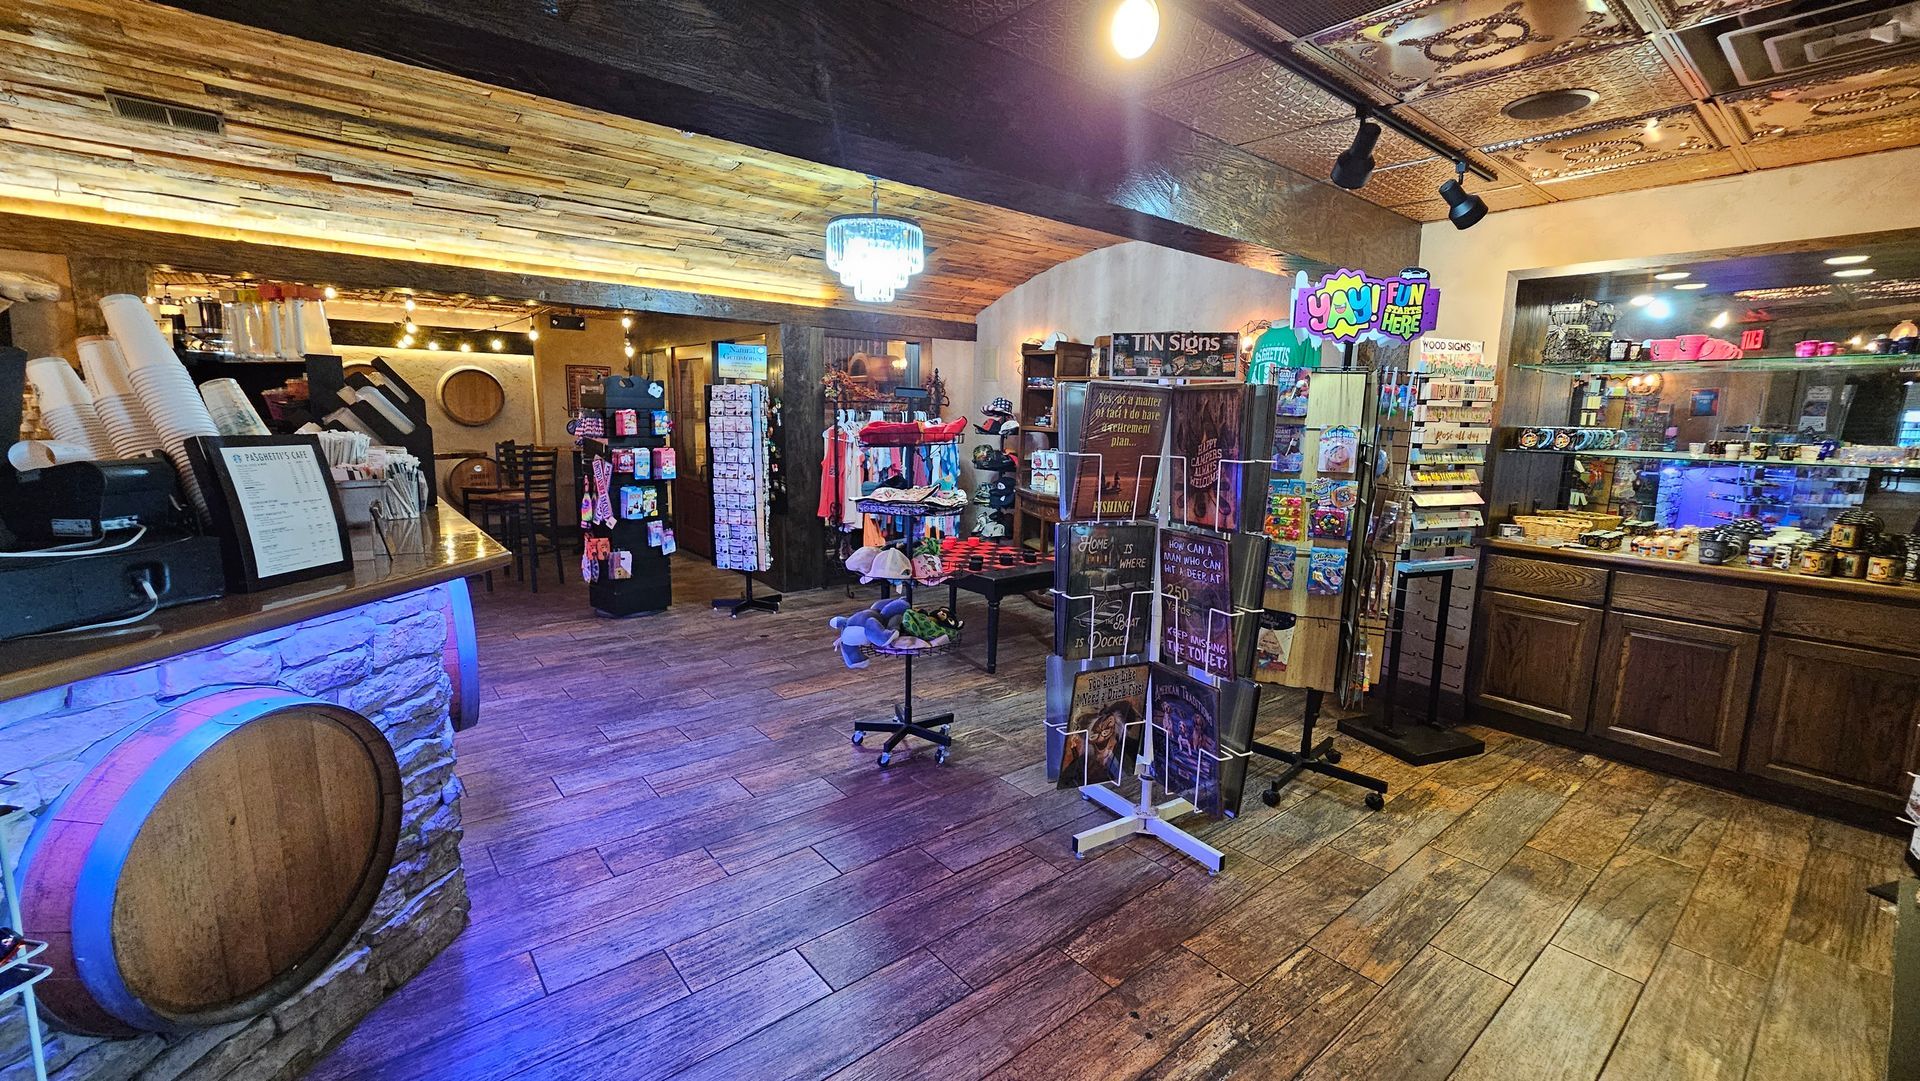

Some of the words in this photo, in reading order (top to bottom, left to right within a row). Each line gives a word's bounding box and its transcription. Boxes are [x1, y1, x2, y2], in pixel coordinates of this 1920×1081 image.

[1386, 281, 1426, 307] FUN
[1307, 283, 1381, 332] YAY!
[1384, 304, 1423, 315] STARTS
[1380, 313, 1422, 337] HERE
[729, 345, 756, 354] Natural
[1131, 334, 1164, 351] TIN
[1168, 334, 1221, 356] Signs
[1423, 340, 1446, 351] WOOD
[1447, 341, 1472, 352] SIGNS
[722, 352, 762, 361] Gemstones
[1116, 395, 1126, 405] as
[1128, 396, 1134, 405] a
[1136, 396, 1162, 407] matter
[1095, 407, 1105, 417] of
[1106, 408, 1121, 418] fact
[1123, 408, 1128, 419] I
[1129, 408, 1140, 419] do
[1141, 409, 1161, 420] have
[1110, 422, 1151, 434] retirement
[1326, 430, 1354, 438] Unicorn
[1110, 436, 1137, 448] plan...
[1455, 430, 1466, 441] all
[1467, 431, 1480, 443] day
[291, 450, 308, 460] CAFE
[1197, 438, 1217, 456] HAPPY
[1190, 448, 1222, 467] CAMPERS
[1193, 460, 1217, 477] ALWAYS
[1091, 500, 1134, 513] FISHING!
[1078, 535, 1109, 554] HOME
[1123, 543, 1134, 554] IS
[1168, 539, 1184, 552] HOW
[1186, 542, 1205, 555] CAN
[1207, 545, 1214, 557] A
[1119, 557, 1147, 569] WHERE
[1163, 551, 1181, 563] MAN
[1183, 555, 1201, 566] WHO
[1202, 558, 1221, 571] CAN
[1164, 563, 1176, 574] HIT
[1179, 566, 1184, 576] A
[1186, 568, 1207, 582] DEER
[1209, 573, 1221, 584] AT
[1167, 583, 1189, 602] 250
[1074, 637, 1085, 648] IS
[1166, 639, 1185, 655] THE
[1088, 678, 1101, 691] You
[1103, 673, 1119, 687] Look
[1121, 669, 1136, 683] Like
[1081, 690, 1100, 705] Need
[1107, 686, 1127, 700] Drink
[1154, 684, 1180, 702] AMERICAN
